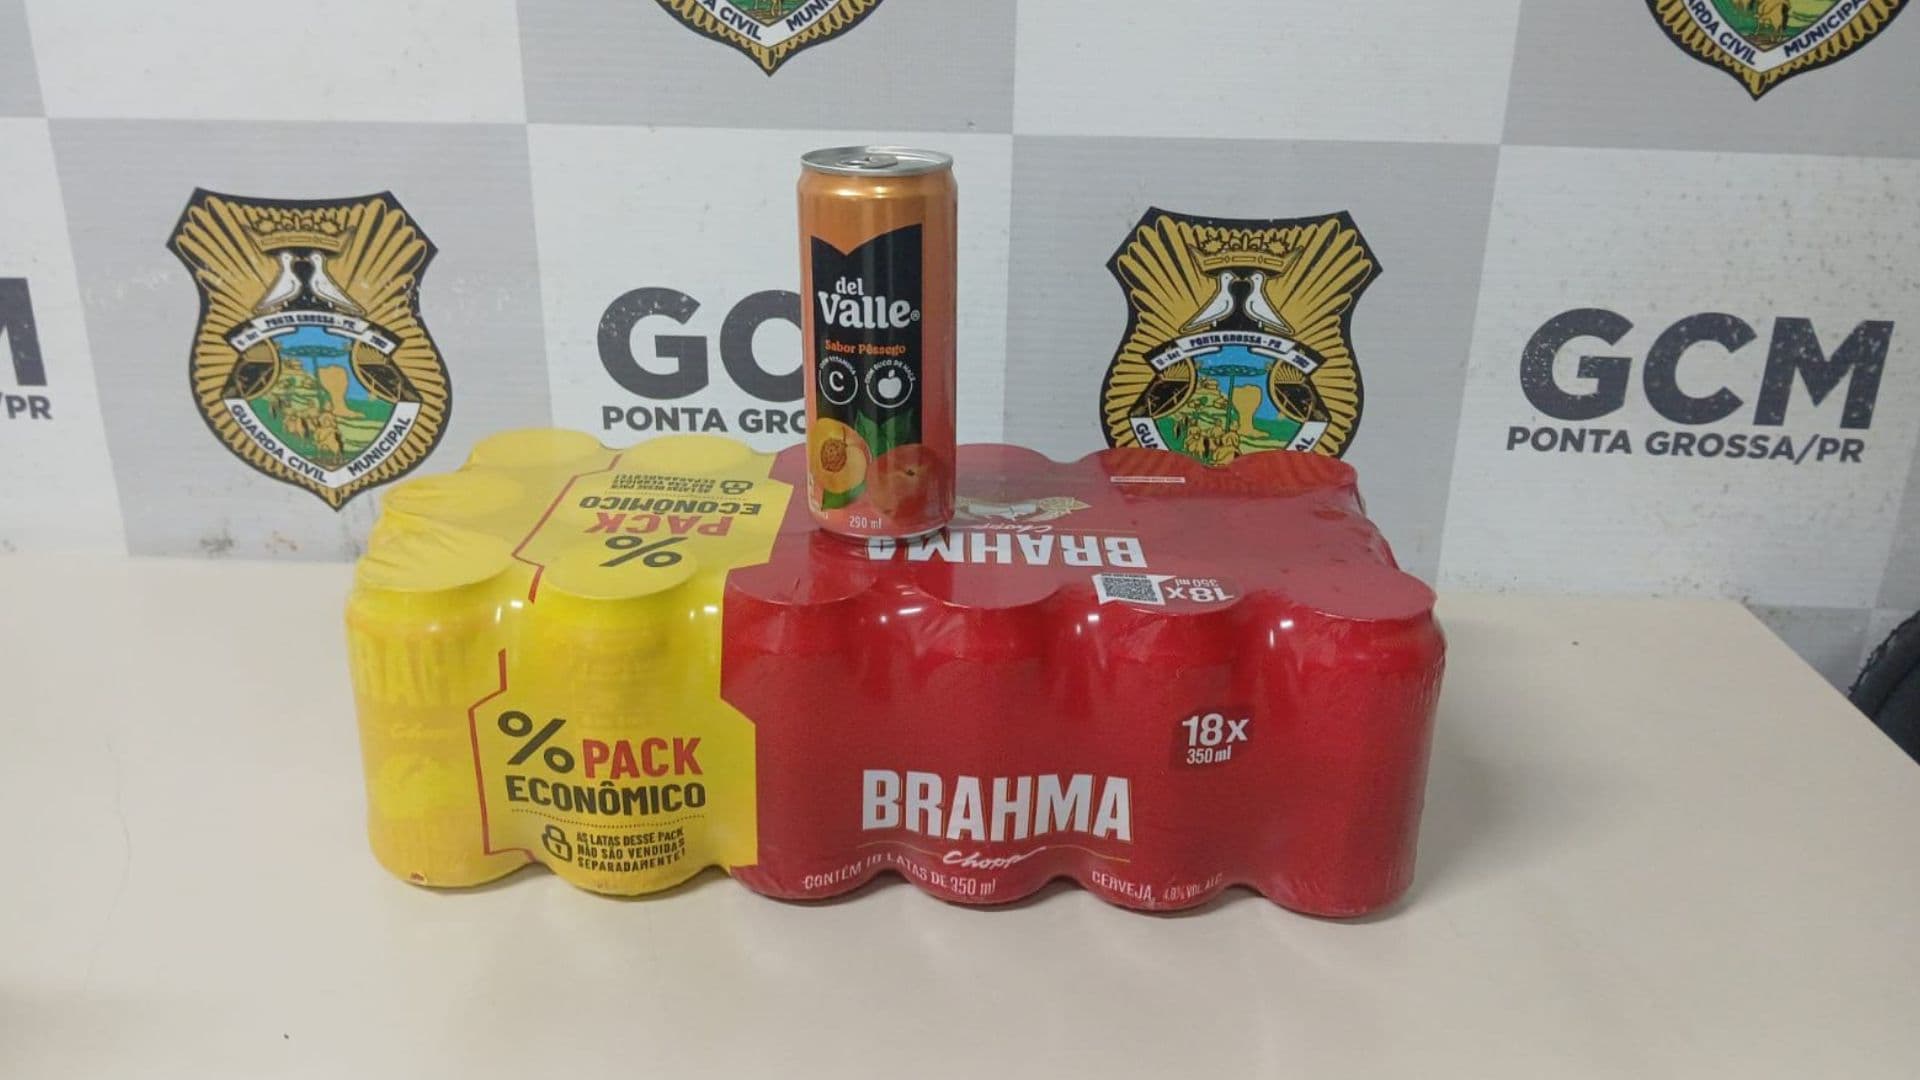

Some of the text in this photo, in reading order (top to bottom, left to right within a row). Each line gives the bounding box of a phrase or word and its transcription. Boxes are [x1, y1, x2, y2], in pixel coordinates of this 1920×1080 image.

[720, 6, 762, 40] CIVIL
[1689, 0, 1720, 36] RDA
[1719, 32, 1756, 65] CIVIL
[835, 276, 864, 296] del
[817, 291, 911, 329] Valle
[825, 338, 906, 357] Sabor Pêssego
[1189, 335, 1221, 348] PONTA
[1222, 334, 1263, 345] GROSSA
[829, 370, 845, 392] C
[1520, 308, 1895, 430] GCM
[0, 393, 53, 420] PR
[602, 406, 728, 433] PONTA
[232, 404, 411, 483] GUARDA CIVIL MUNICIPAL
[1506, 426, 1865, 465] PONTA GROSSA/PR
[579, 495, 762, 516] ECONÔMICO
[583, 512, 734, 537] PACK
[849, 515, 882, 529] 290 ml
[582, 737, 703, 779] PACK
[1186, 745, 1232, 765] 350 ml
[505, 775, 706, 816] ECONÔMICO
[862, 769, 1132, 842] BRAHMA
[590, 833, 620, 847] LATAS
[623, 832, 656, 847] DESSE
[658, 827, 684, 843] PACK
[627, 837, 686, 860] VENDIDAS
[886, 852, 928, 881] LATAS
[950, 876, 977, 896] 350
[980, 877, 996, 896] ml
